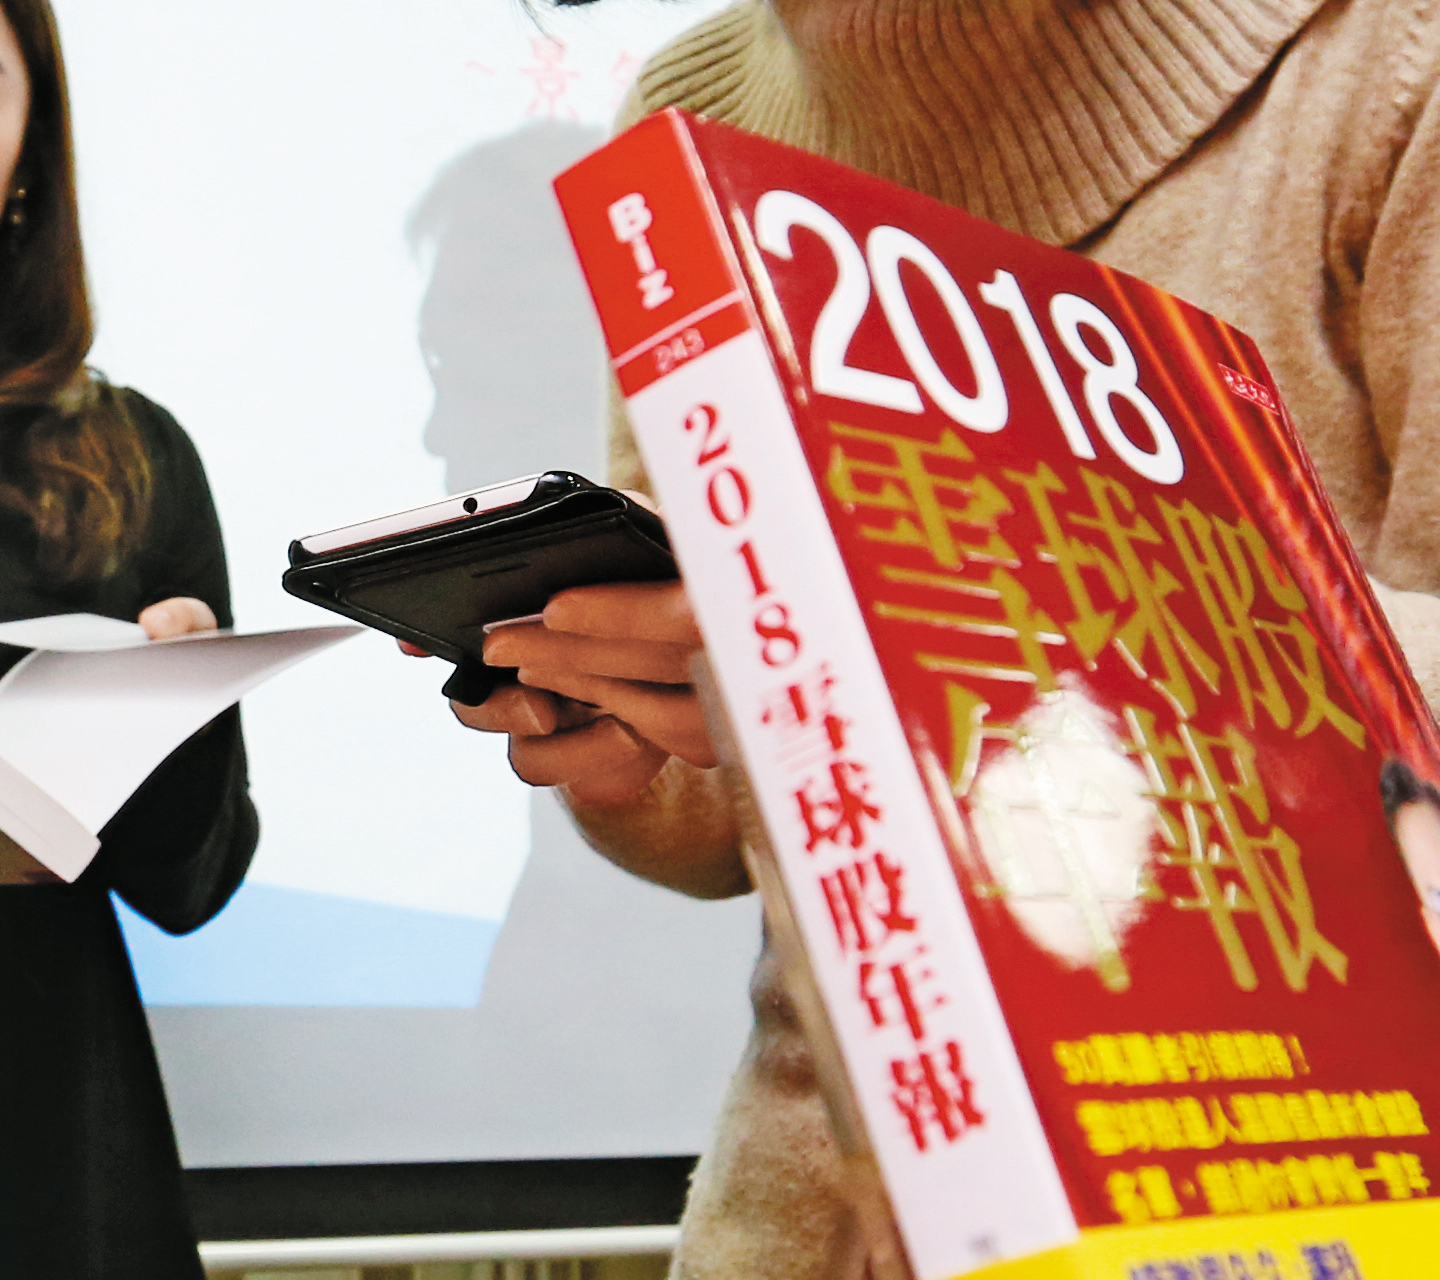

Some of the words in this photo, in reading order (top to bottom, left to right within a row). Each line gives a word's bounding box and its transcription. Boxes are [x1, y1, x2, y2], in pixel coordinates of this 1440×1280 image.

[756, 189, 1185, 486] 2018
[826, 423, 1367, 749] 雪球股
